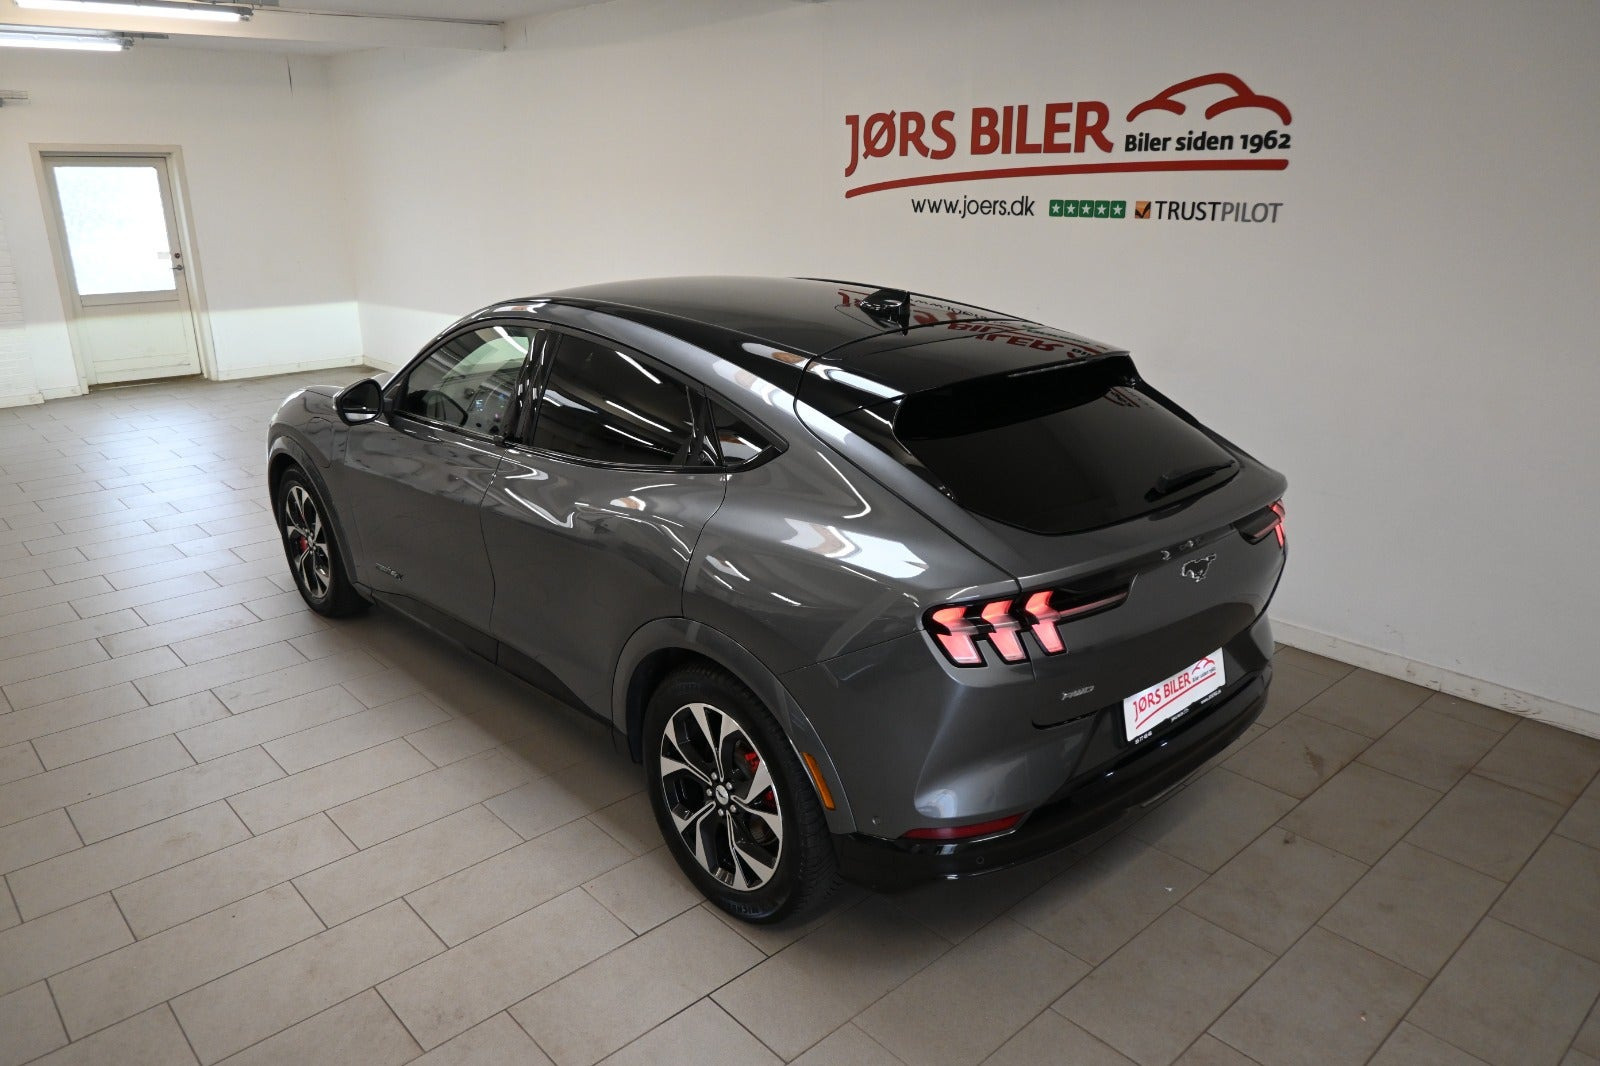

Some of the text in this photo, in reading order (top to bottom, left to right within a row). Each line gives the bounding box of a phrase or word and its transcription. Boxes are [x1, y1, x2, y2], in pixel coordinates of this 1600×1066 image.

[845, 101, 1114, 177] JØRS BILER
[1124, 130, 1292, 153] Biler siden 1962
[911, 195, 1035, 219] www.joers.dk
[1155, 201, 1284, 223] TRUSTPILOT
[1133, 688, 1161, 722] JØRS
[1163, 672, 1191, 699] BILER
